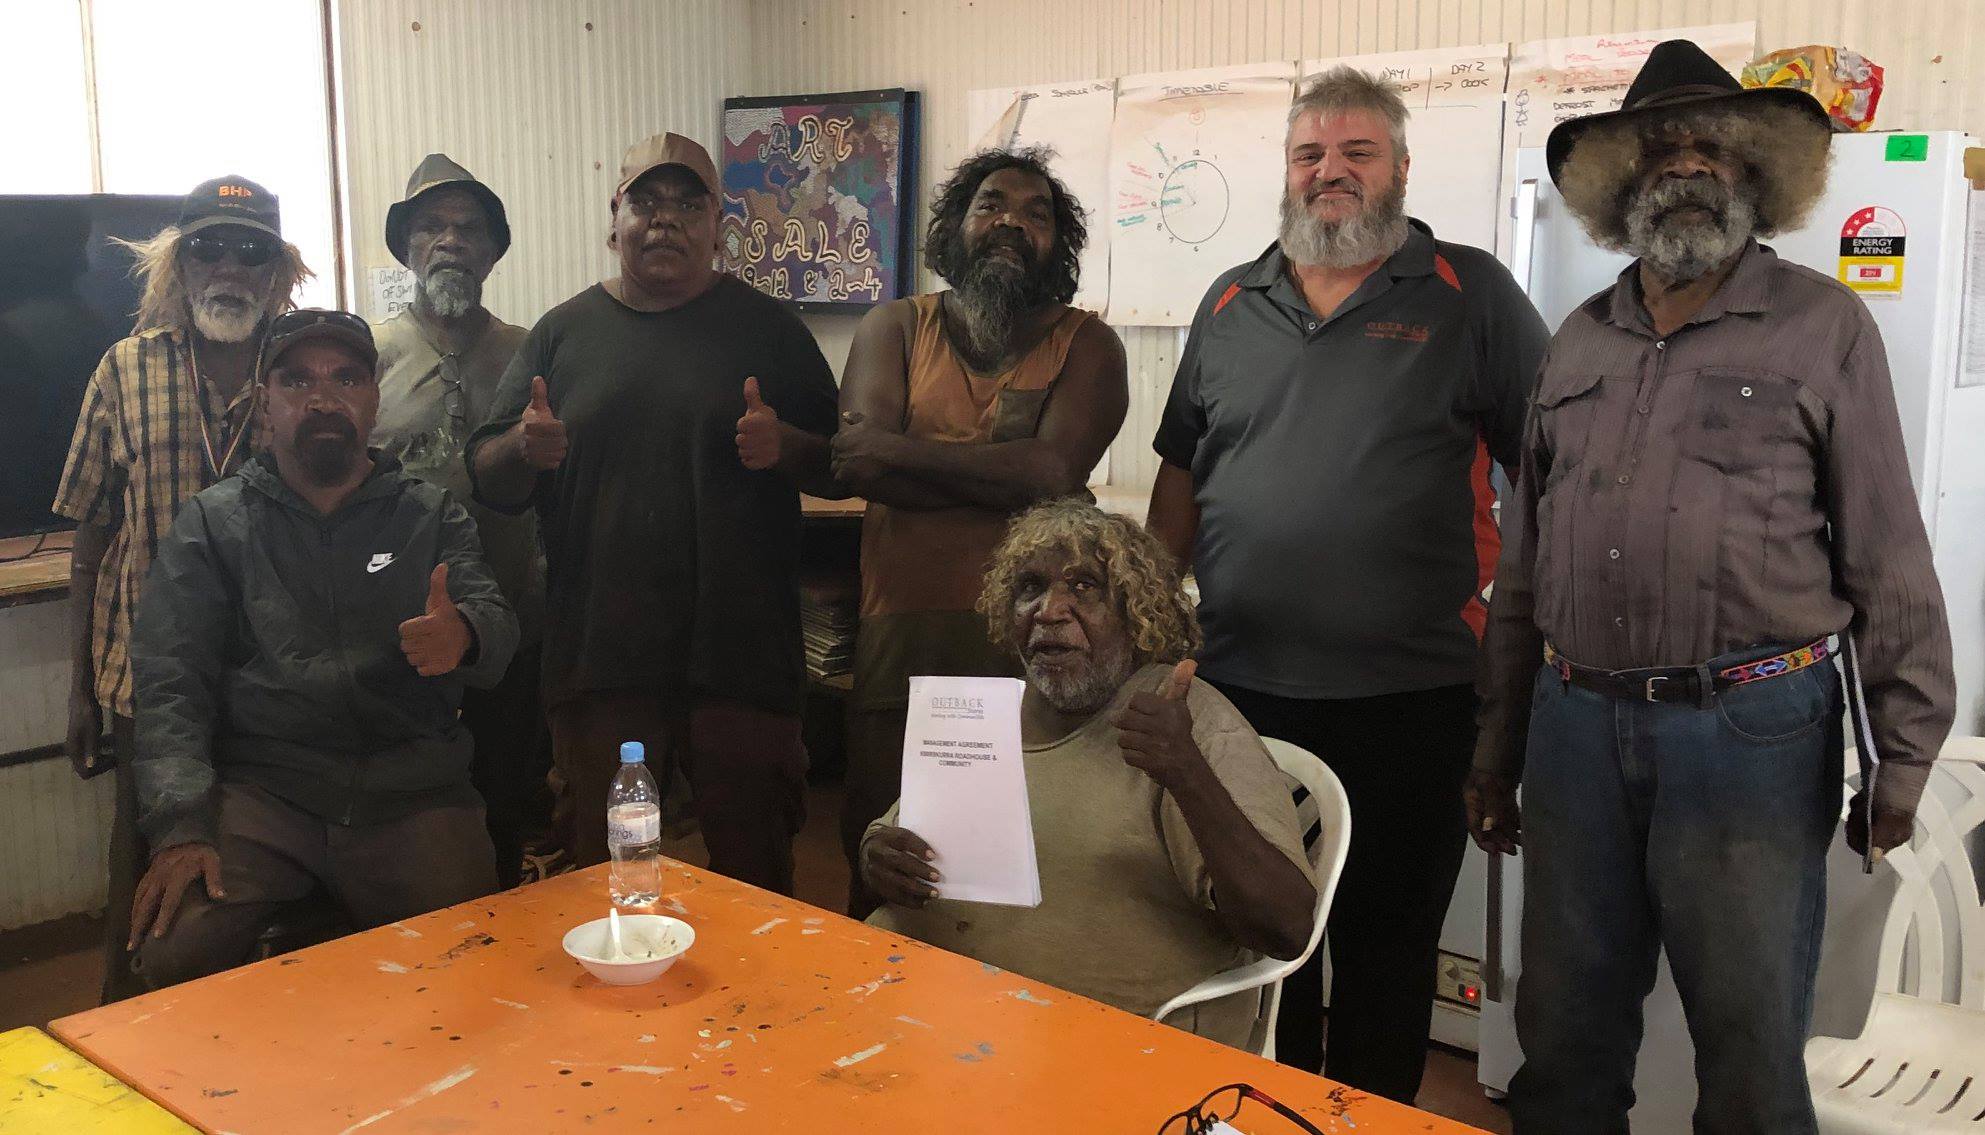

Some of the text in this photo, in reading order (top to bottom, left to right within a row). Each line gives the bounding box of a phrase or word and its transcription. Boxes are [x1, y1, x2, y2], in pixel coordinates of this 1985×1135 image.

[1382, 66, 1405, 80] DAY
[1451, 61, 1485, 75] DAY 2
[758, 114, 853, 164] ART
[1899, 140, 1915, 158] 2
[743, 218, 871, 263] SALE
[1852, 238, 1894, 247] ENERGY
[1853, 246, 1893, 255] RATING
[742, 264, 792, 299] 9-12
[828, 267, 883, 301] 2-4
[931, 696, 985, 708] OUTBACK
[923, 739, 994, 749] MANAGEMENT AGREEMENT
[954, 752, 991, 761] ROADHOUSE
